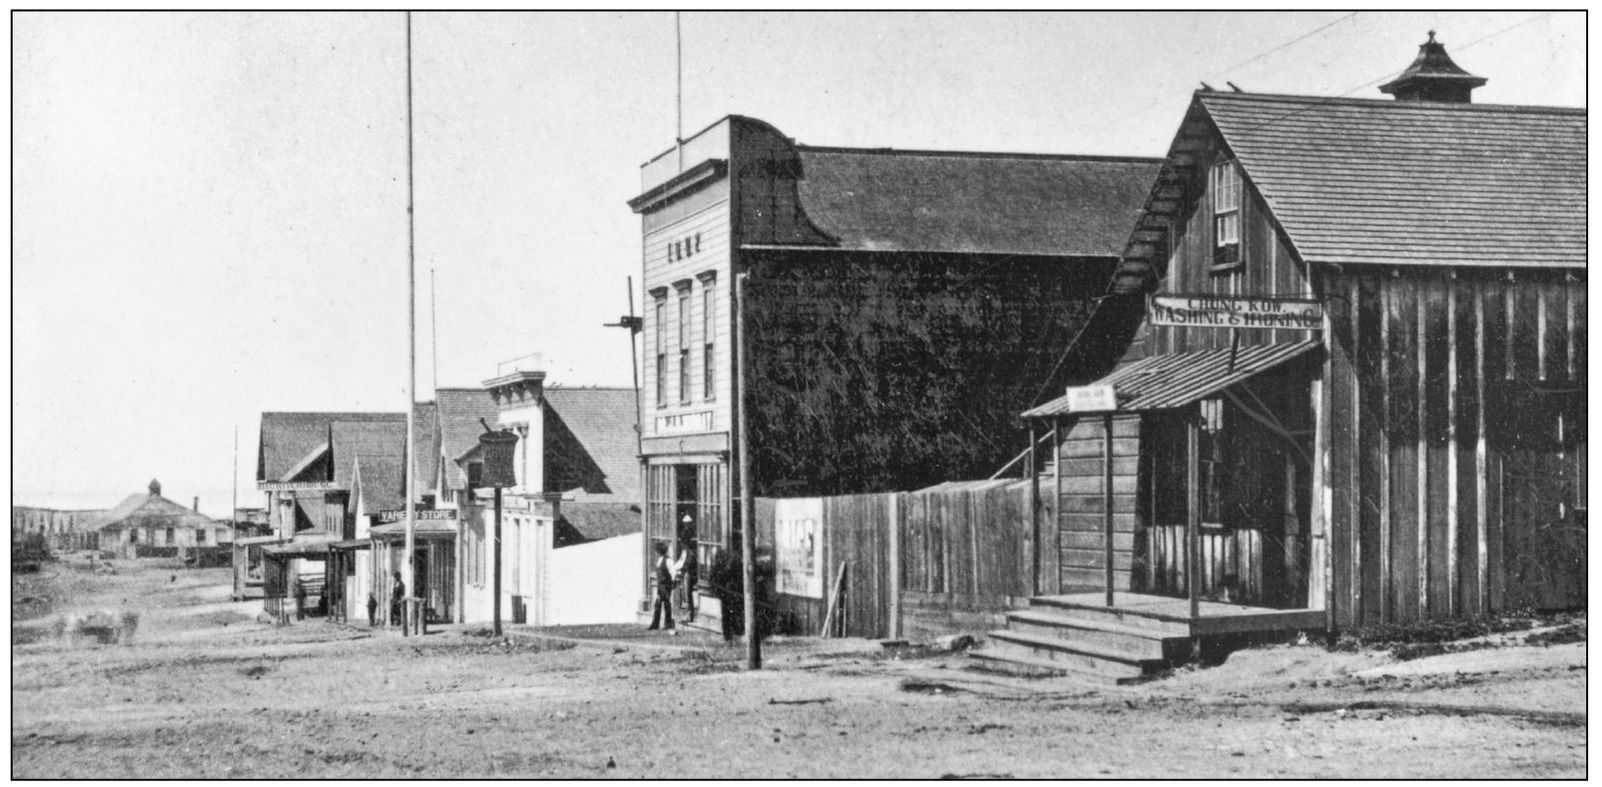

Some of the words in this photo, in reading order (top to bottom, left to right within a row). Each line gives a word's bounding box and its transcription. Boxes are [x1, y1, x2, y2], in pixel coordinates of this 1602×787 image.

[1153, 303, 1224, 325] WASHING
[1228, 306, 1241, 325] &
[381, 510, 419, 521] VARIEY
[421, 510, 452, 521] STORE
